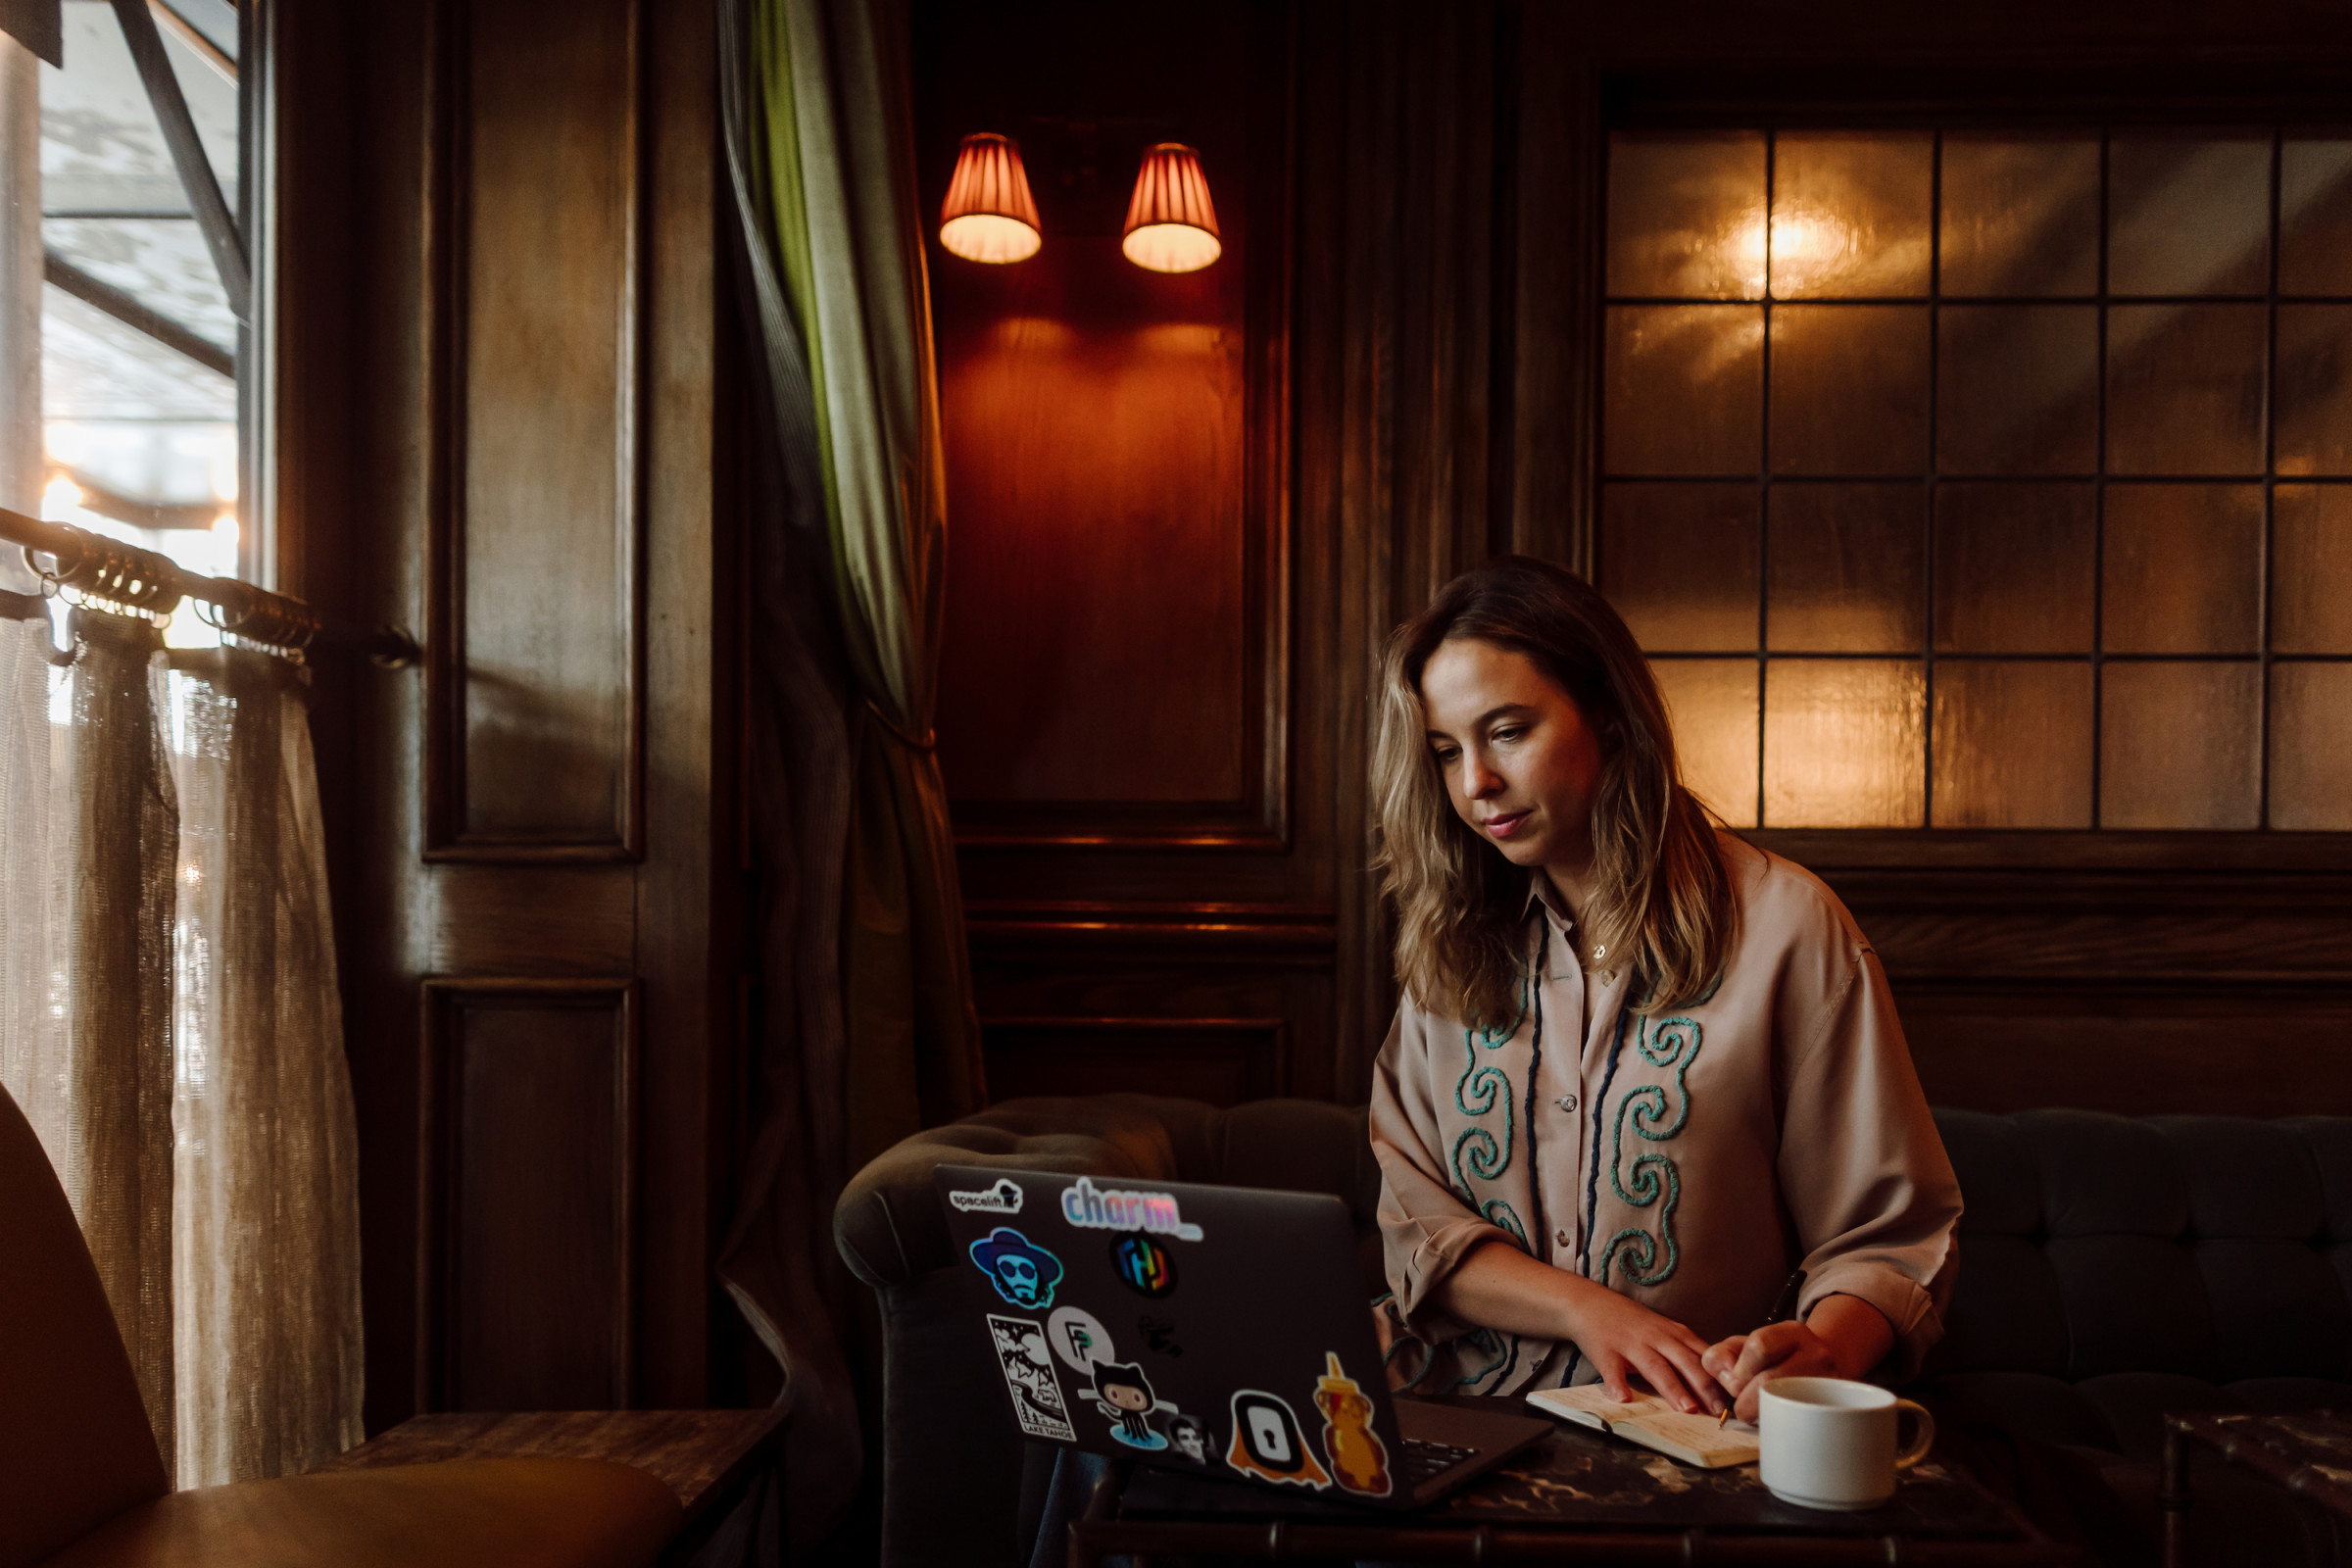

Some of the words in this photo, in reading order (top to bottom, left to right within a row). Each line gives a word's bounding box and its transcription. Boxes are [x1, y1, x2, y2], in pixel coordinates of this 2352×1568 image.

[953, 1195, 1003, 1208] spacelift
[1065, 1183, 1174, 1227] charm
[1023, 1423, 1045, 1434] LAKE
[1045, 1428, 1073, 1440] TAHOE
